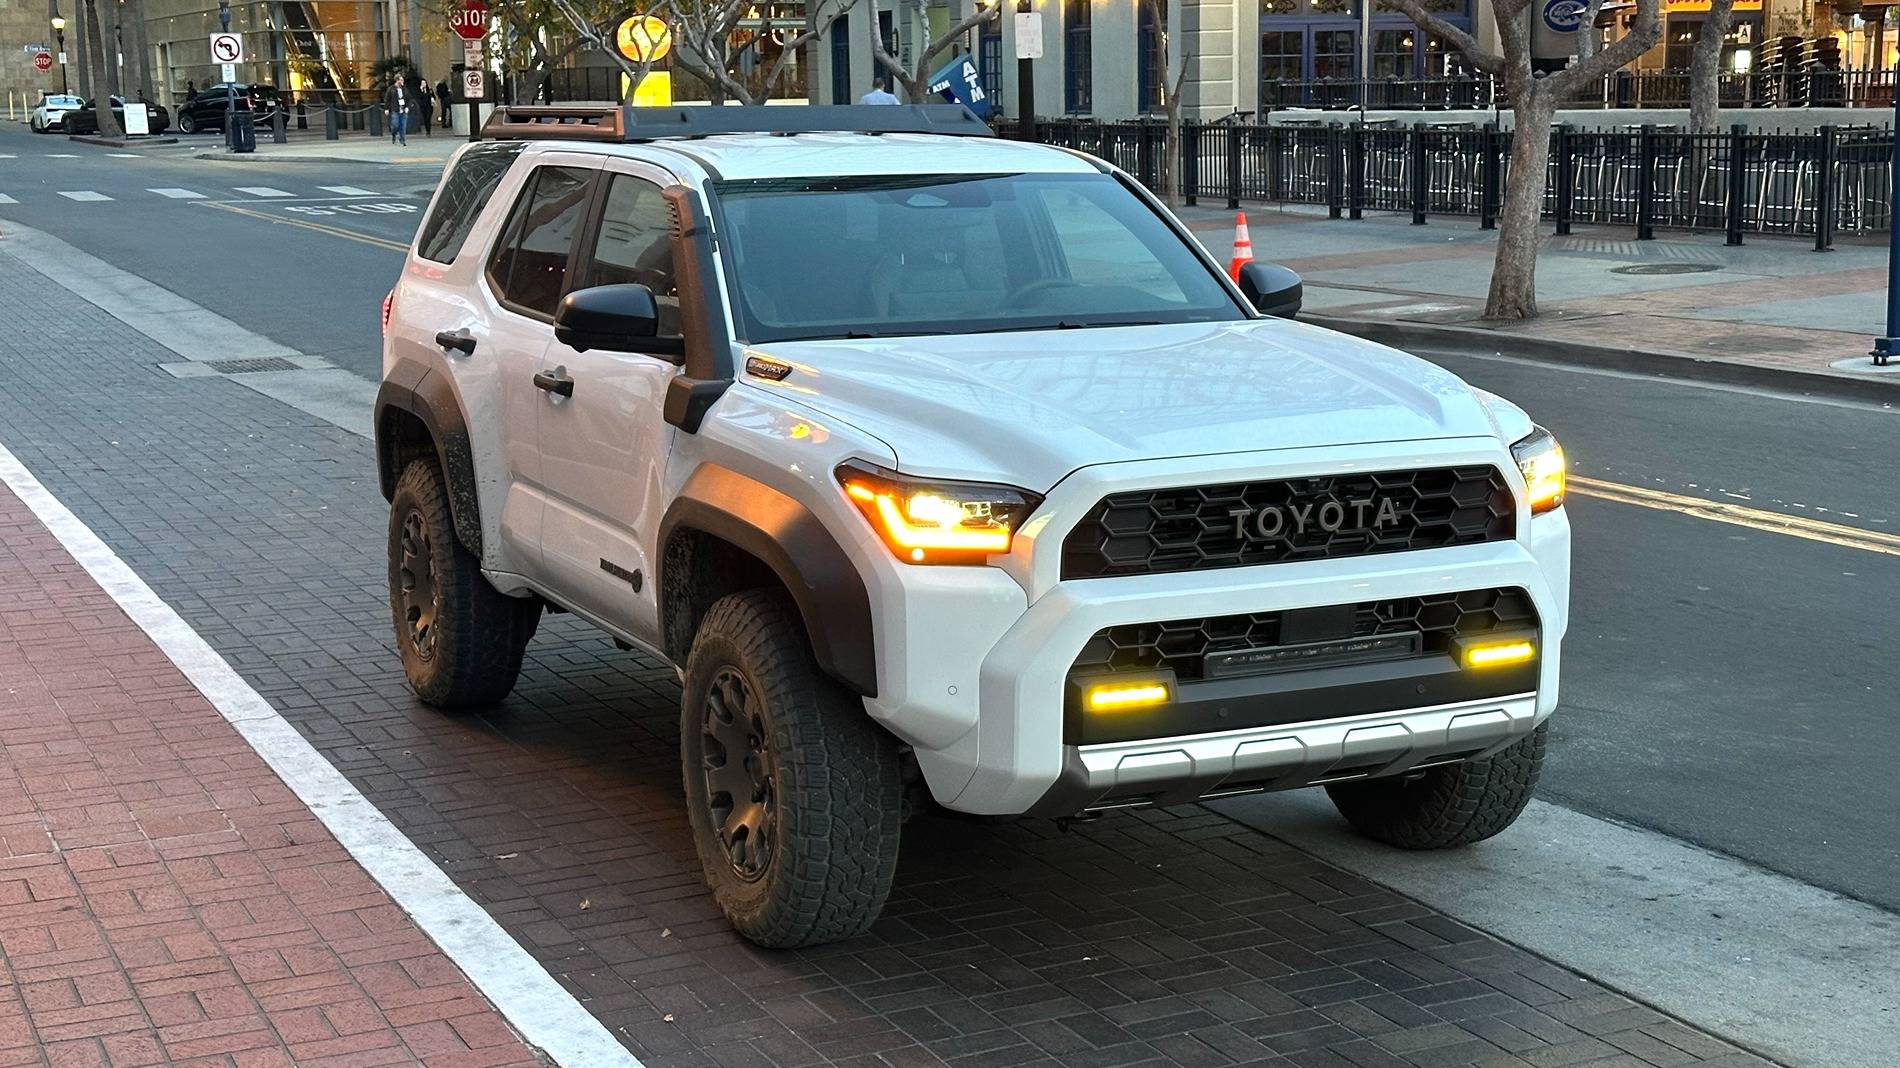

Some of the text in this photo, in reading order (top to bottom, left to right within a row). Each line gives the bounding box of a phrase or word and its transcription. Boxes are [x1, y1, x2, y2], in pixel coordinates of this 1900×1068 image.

[1740, 27, 1748, 38] A
[35, 57, 51, 65] STOP
[932, 79, 951, 93] ATM
[963, 61, 985, 103] ATM
[284, 203, 418, 215] STOP
[1229, 497, 1398, 539] TOYOTA
